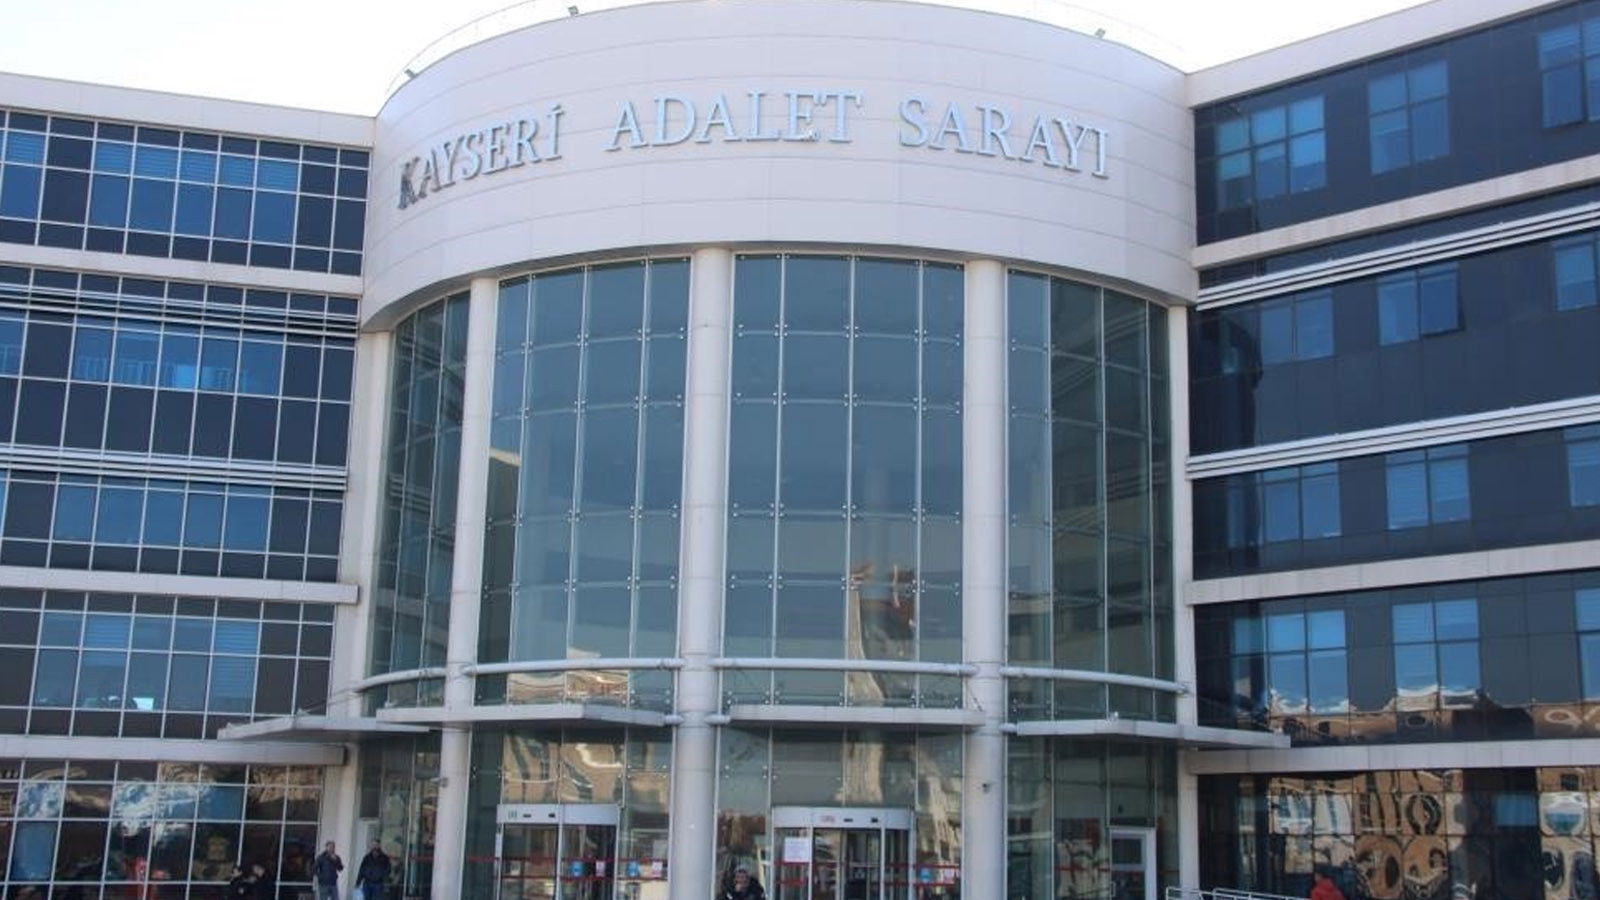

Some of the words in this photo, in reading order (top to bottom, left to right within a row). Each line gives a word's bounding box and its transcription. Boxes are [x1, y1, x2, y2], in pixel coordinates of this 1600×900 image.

[397, 104, 565, 210] KAYSERİ
[603, 89, 864, 152] ADALET
[899, 97, 1109, 179] SARAYI
